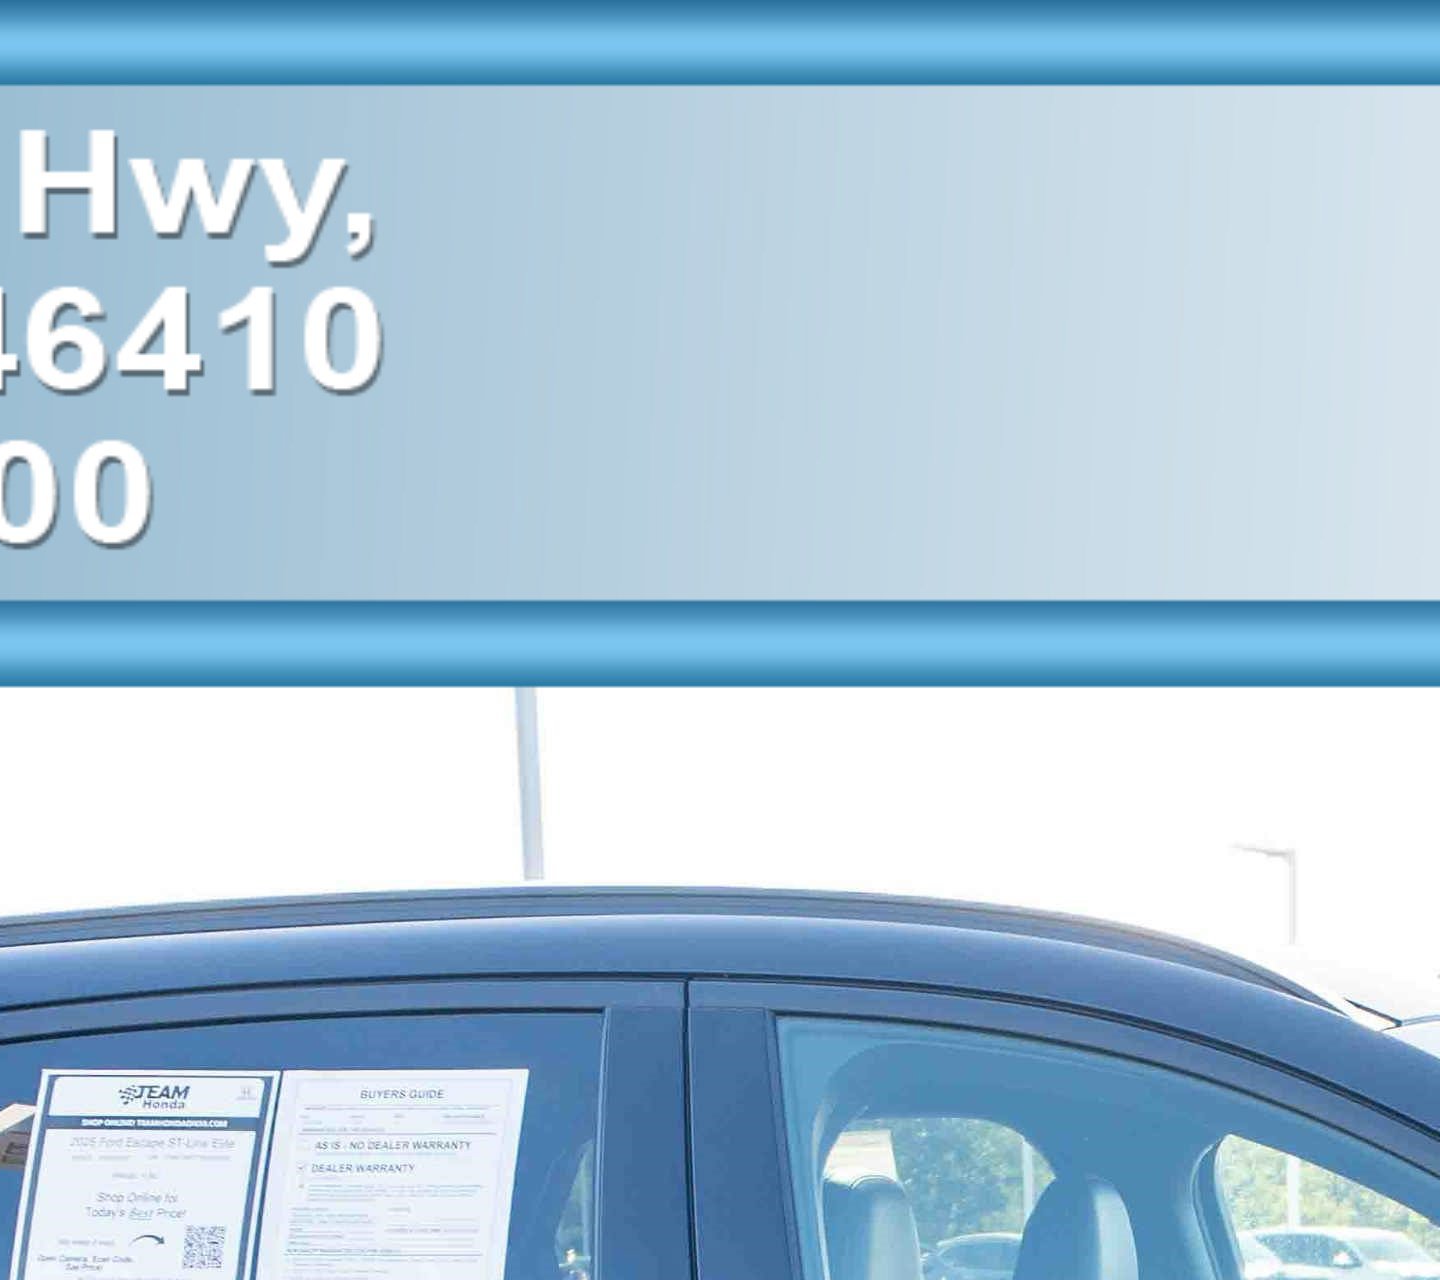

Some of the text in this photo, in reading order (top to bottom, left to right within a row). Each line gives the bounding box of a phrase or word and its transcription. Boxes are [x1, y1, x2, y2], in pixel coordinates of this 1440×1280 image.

[135, 1085, 191, 1099] TEAM
[360, 1089, 445, 1100] BUYERS GUIDE
[142, 1100, 185, 1110] Honda
[315, 1141, 329, 1150] AS
[331, 1141, 341, 1150] IS
[349, 1141, 364, 1150] NO
[367, 1141, 410, 1150] DEALER
[412, 1141, 471, 1150] WARRANTY
[311, 1164, 416, 1173] DEALER WARRANTY
[96, 1192, 124, 1204] Shop
[127, 1192, 162, 1203] Online
[84, 1206, 126, 1219] Today's
